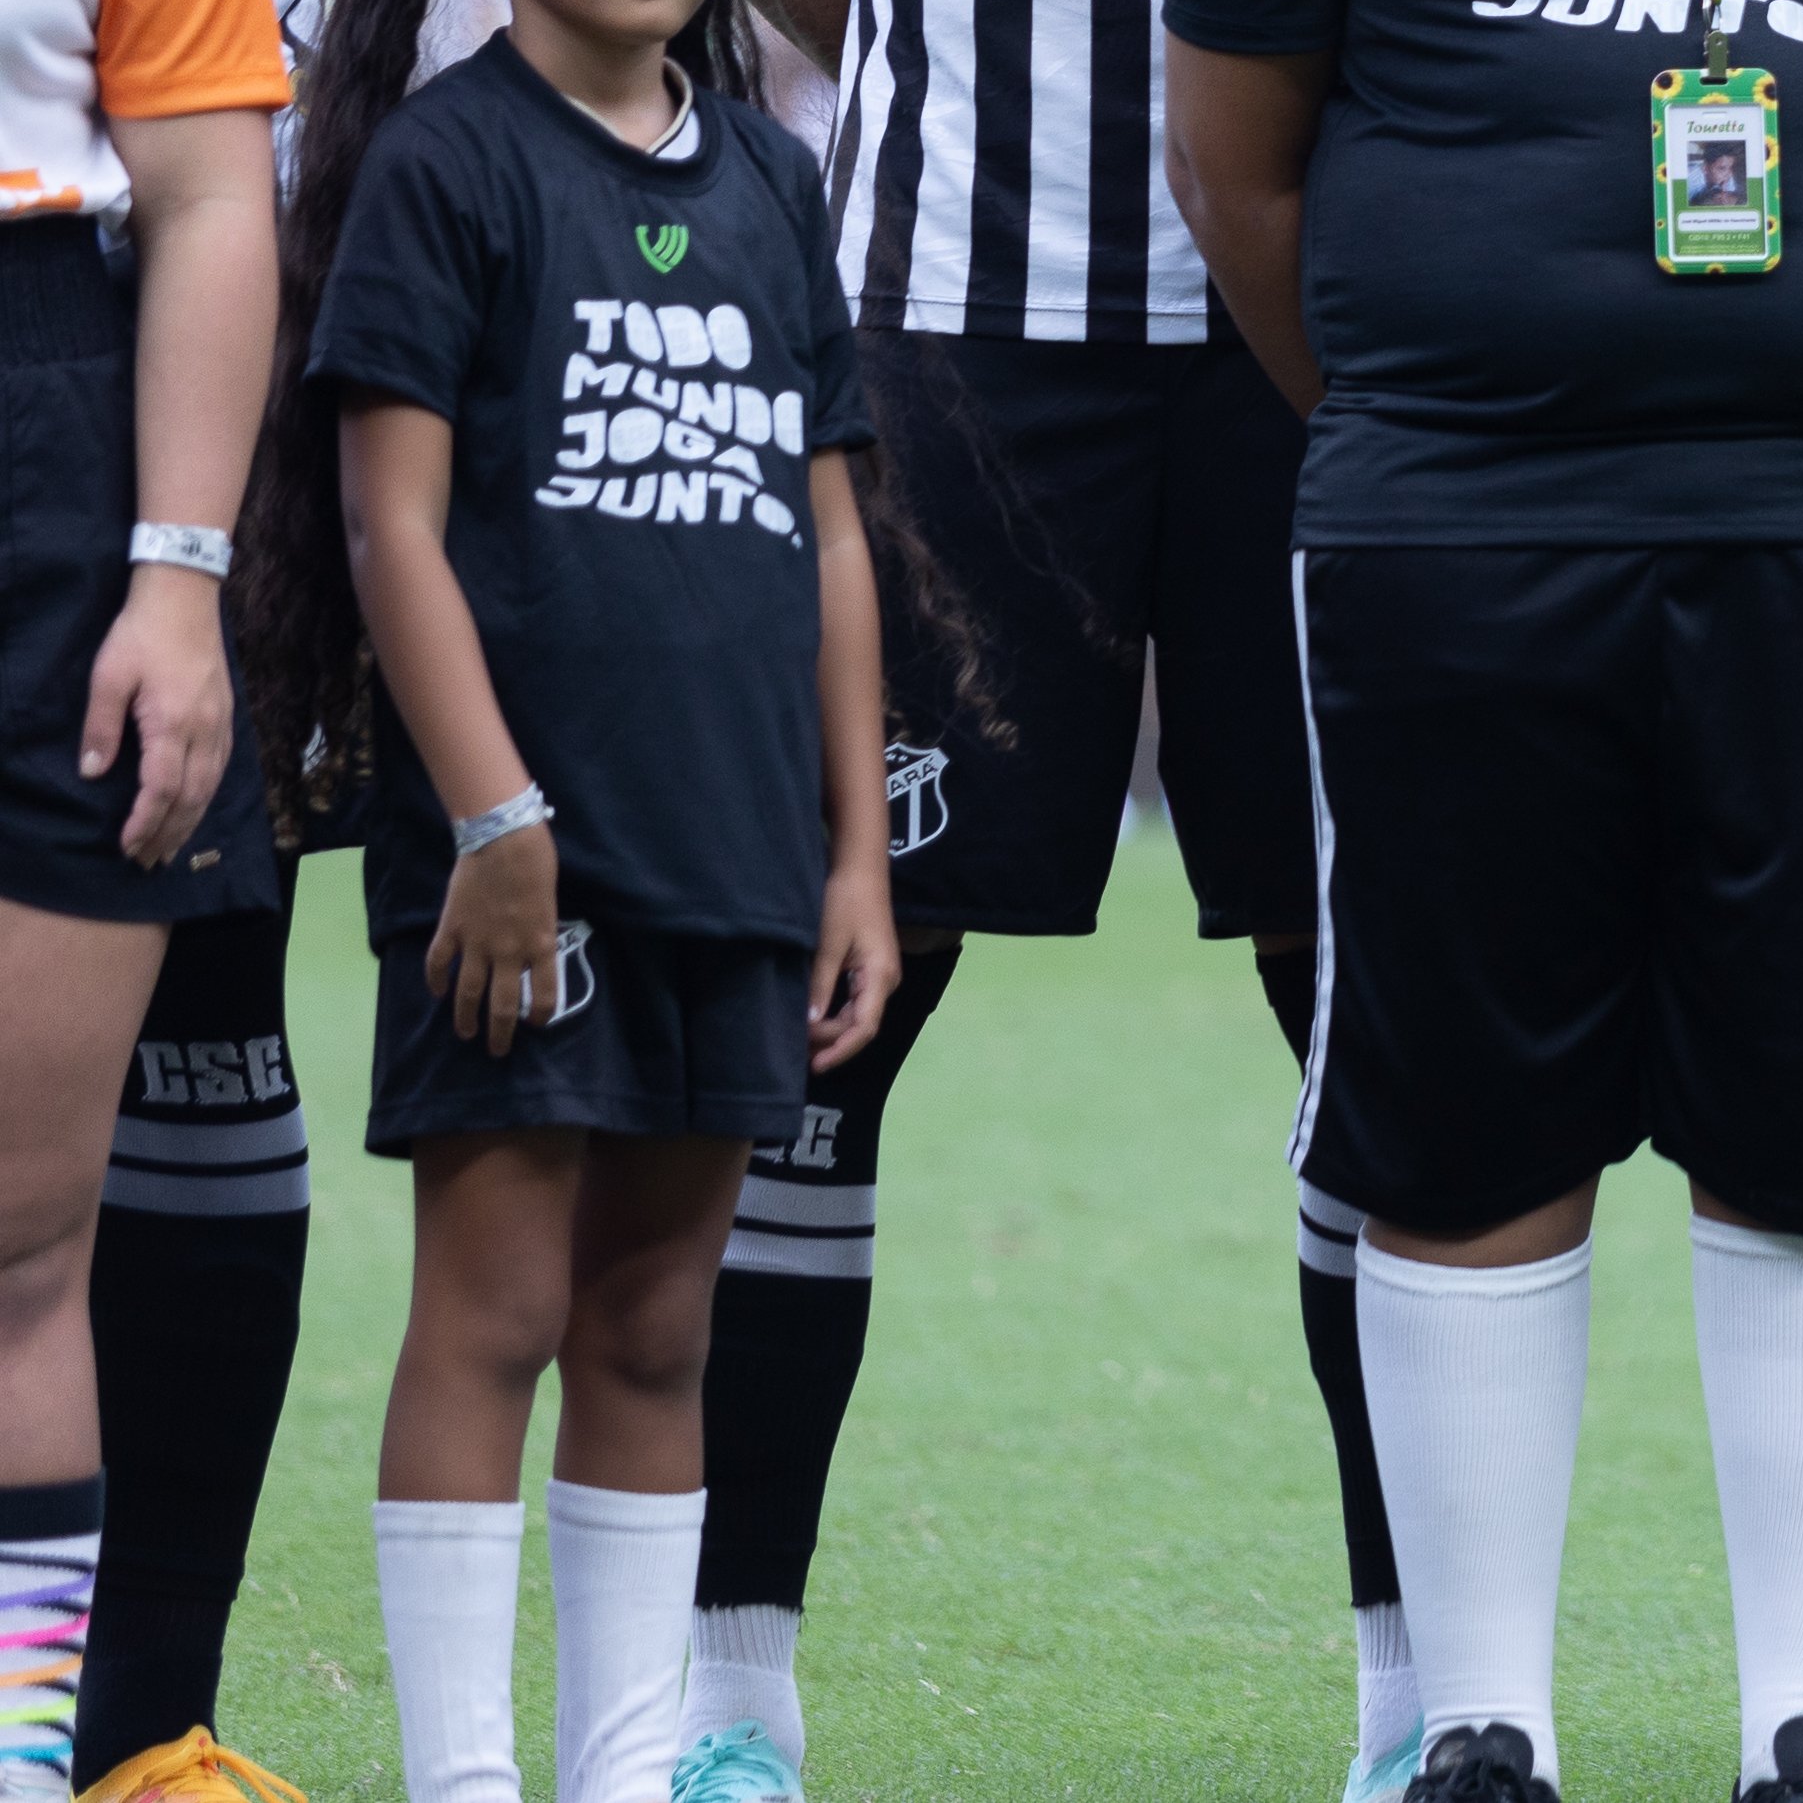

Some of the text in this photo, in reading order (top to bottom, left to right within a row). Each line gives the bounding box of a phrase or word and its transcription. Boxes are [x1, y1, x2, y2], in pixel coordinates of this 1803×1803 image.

[573, 299, 752, 372] TODO
[562, 352, 804, 457] MUNDO
[556, 407, 765, 486] JOGA
